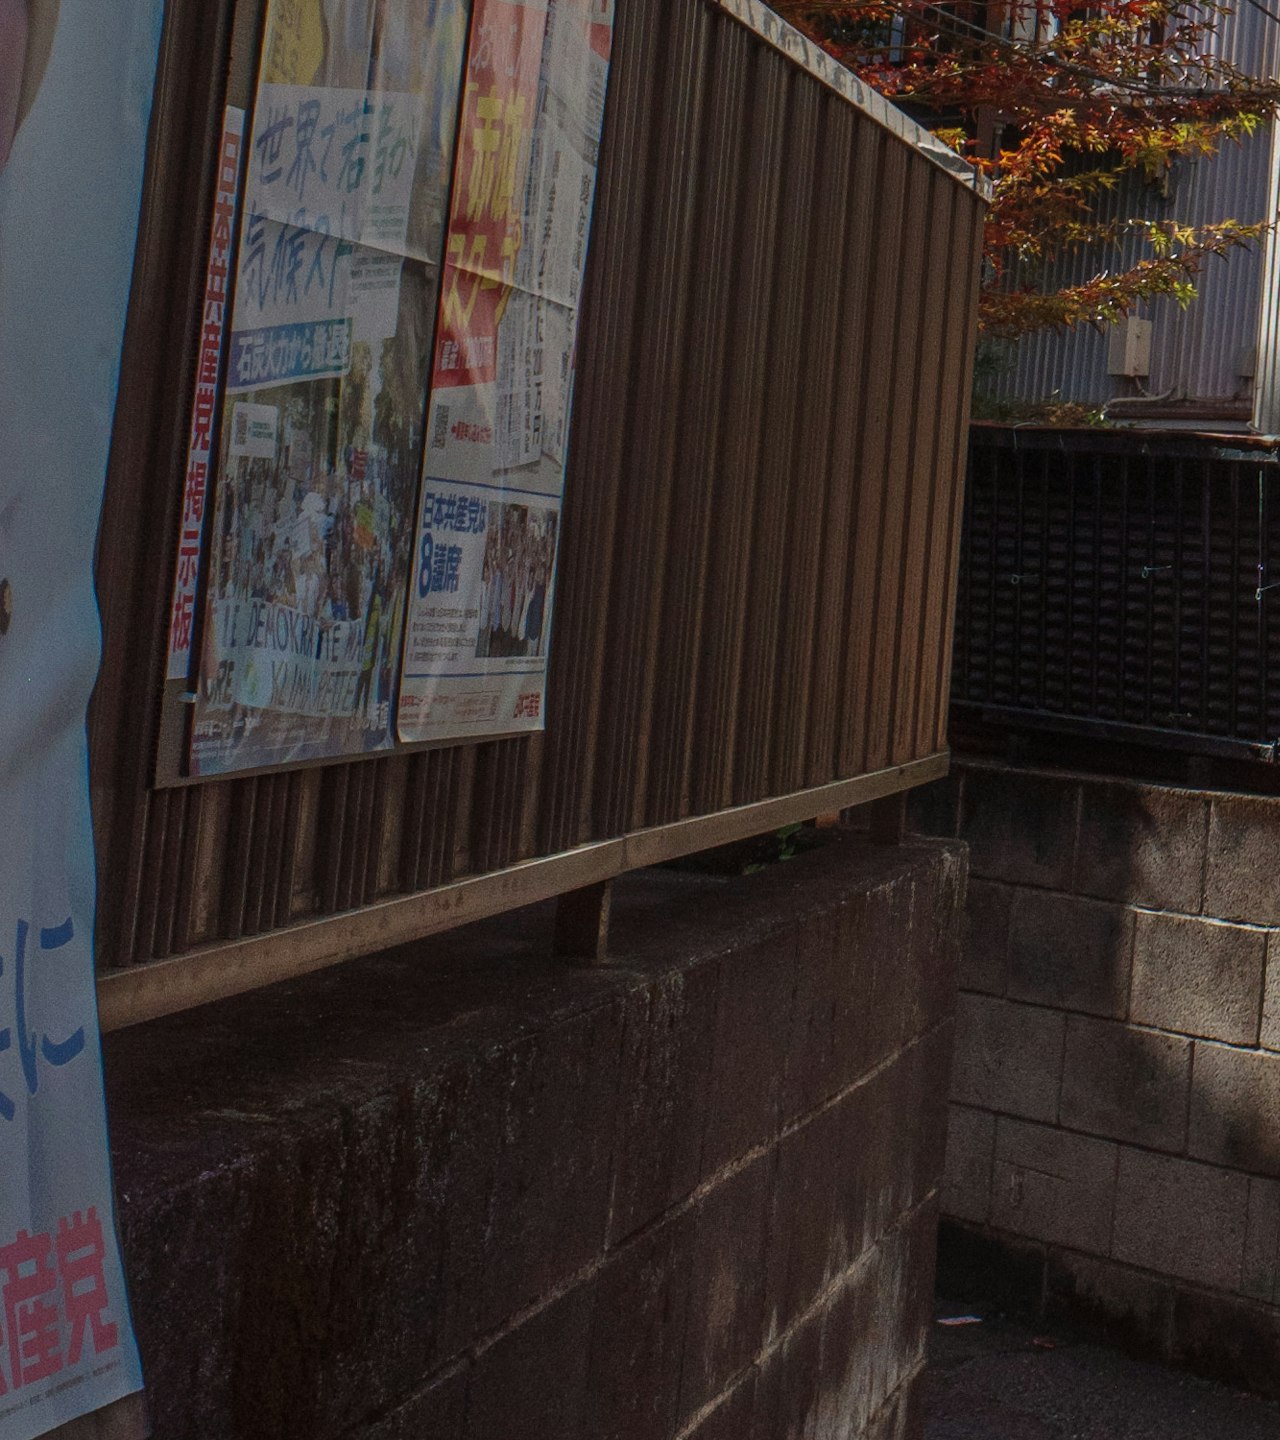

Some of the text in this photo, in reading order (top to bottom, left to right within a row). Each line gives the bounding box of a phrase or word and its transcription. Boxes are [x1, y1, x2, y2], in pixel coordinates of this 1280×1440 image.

[240, 200, 353, 311] 気候スト
[172, 130, 239, 653] 日本共産党 掲示板
[418, 531, 463, 600] 8議席
[422, 491, 488, 536] 日本共産党は
[0, 917, 85, 1121] に
[0, 1205, 118, 1397] 産党
